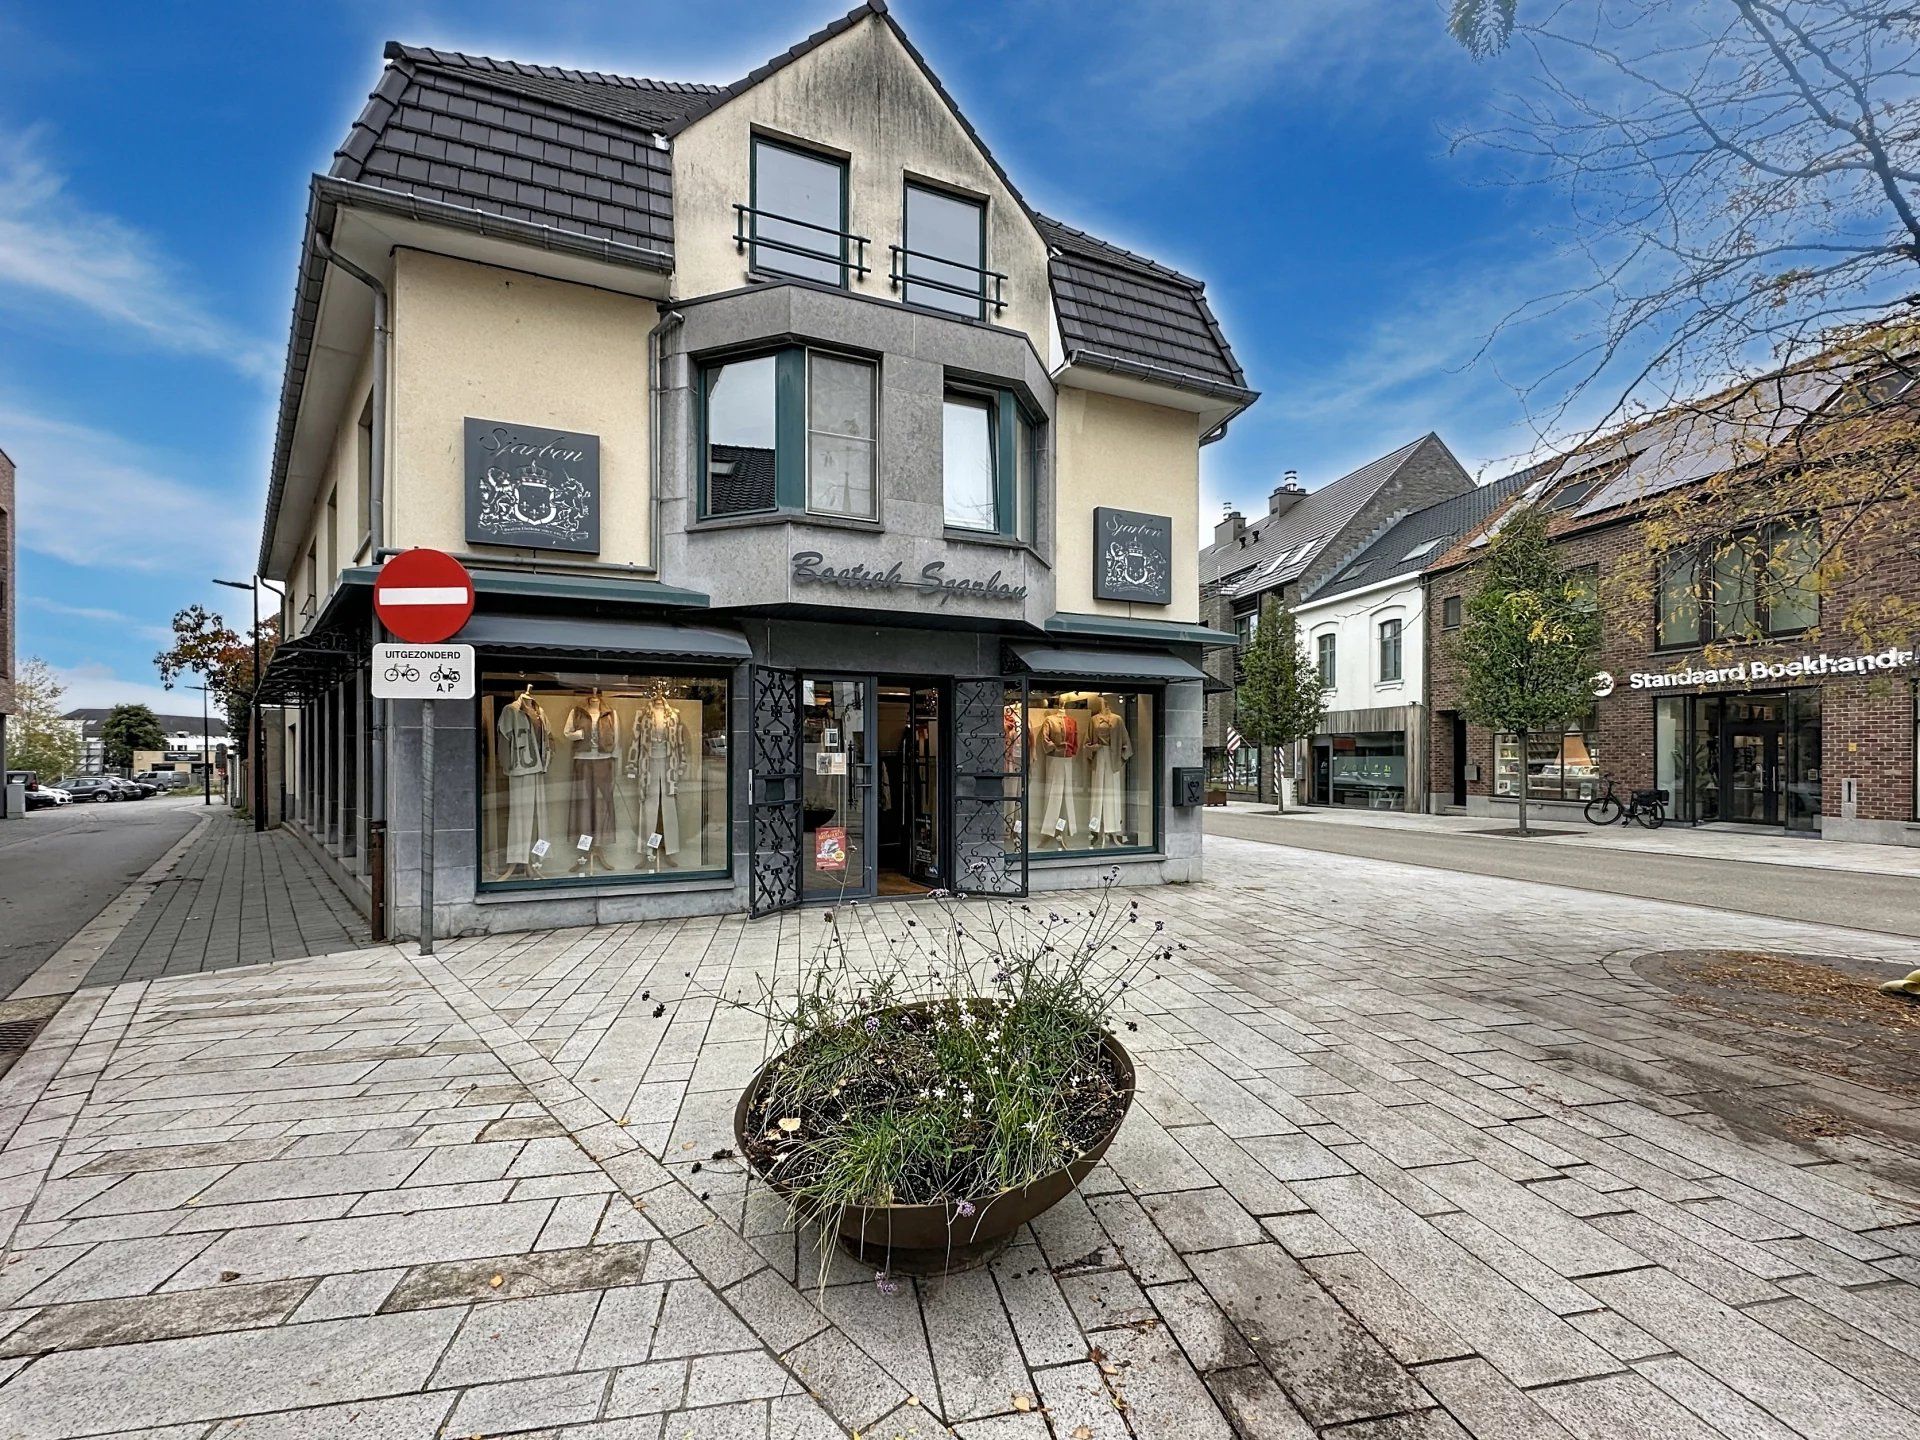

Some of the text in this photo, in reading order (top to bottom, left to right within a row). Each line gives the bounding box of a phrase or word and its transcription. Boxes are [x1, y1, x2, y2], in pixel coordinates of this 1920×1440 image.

[479, 427, 584, 462] Sjarbon
[918, 561, 1029, 606] Sjarbon
[385, 650, 461, 660] UITGEZONDERD
[1629, 663, 1746, 689] Standaard
